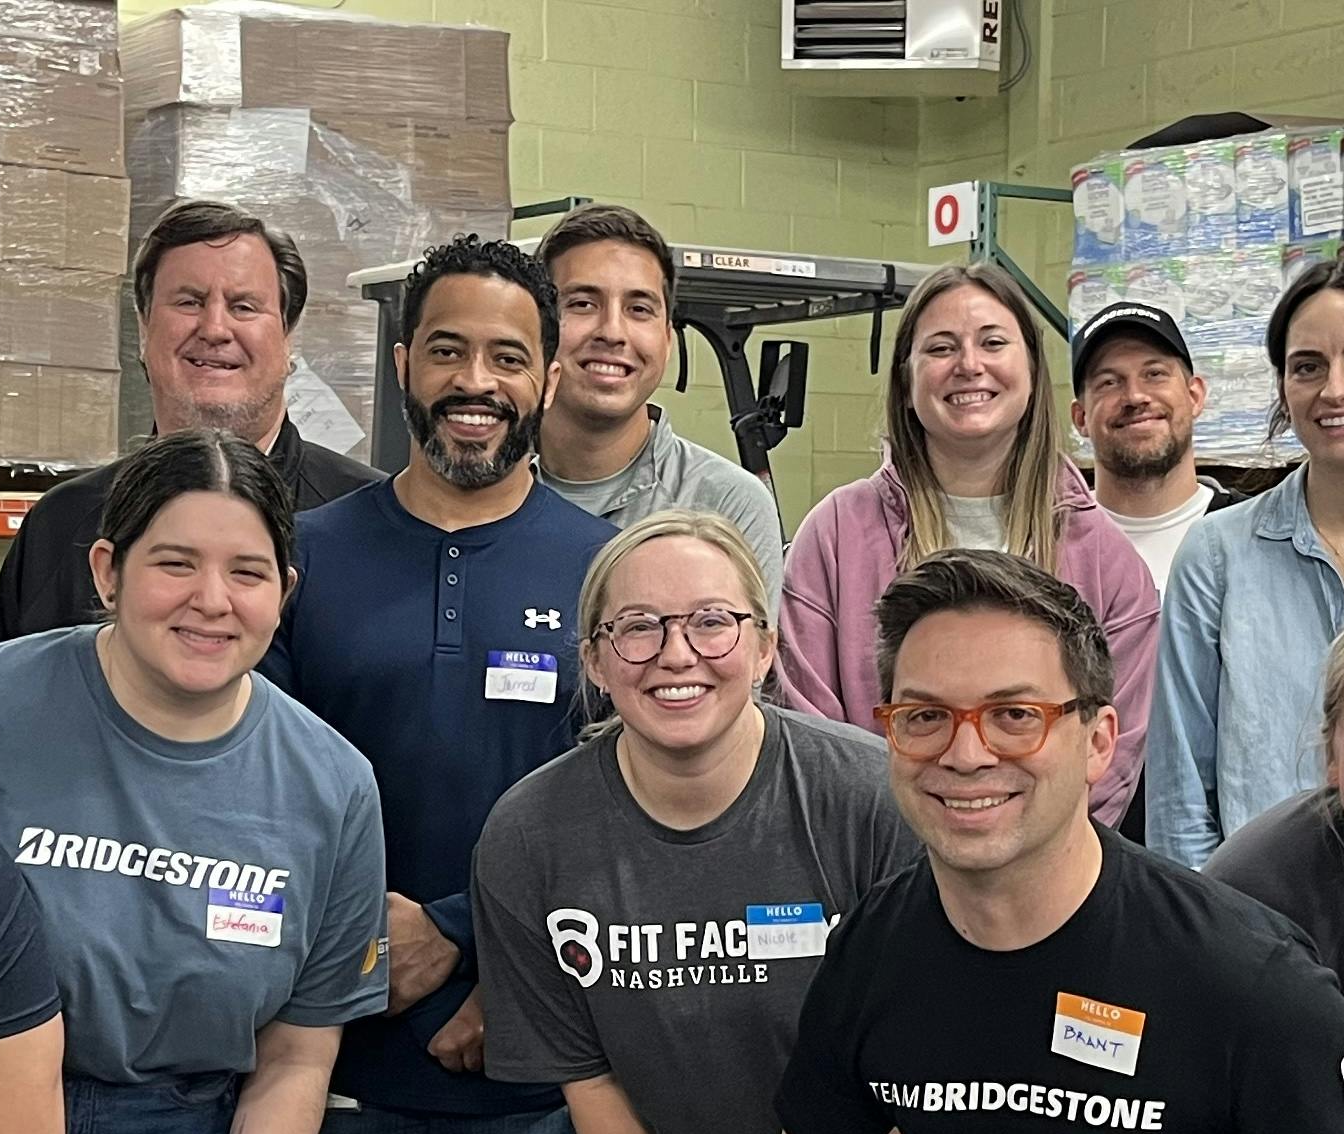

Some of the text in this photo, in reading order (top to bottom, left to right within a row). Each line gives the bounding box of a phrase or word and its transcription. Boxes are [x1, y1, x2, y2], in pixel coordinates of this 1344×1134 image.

[715, 255, 751, 268] CLEAR
[505, 652, 540, 664] HELLO
[14, 826, 291, 896] BRIDGESTONE
[229, 890, 265, 904] HELLO
[766, 906, 803, 917] HELLO
[608, 912, 842, 963] FIT FACY
[610, 964, 769, 990] NASHVILLE
[1080, 1000, 1121, 1020] HELLO
[1063, 1024, 1124, 1058] BRANT
